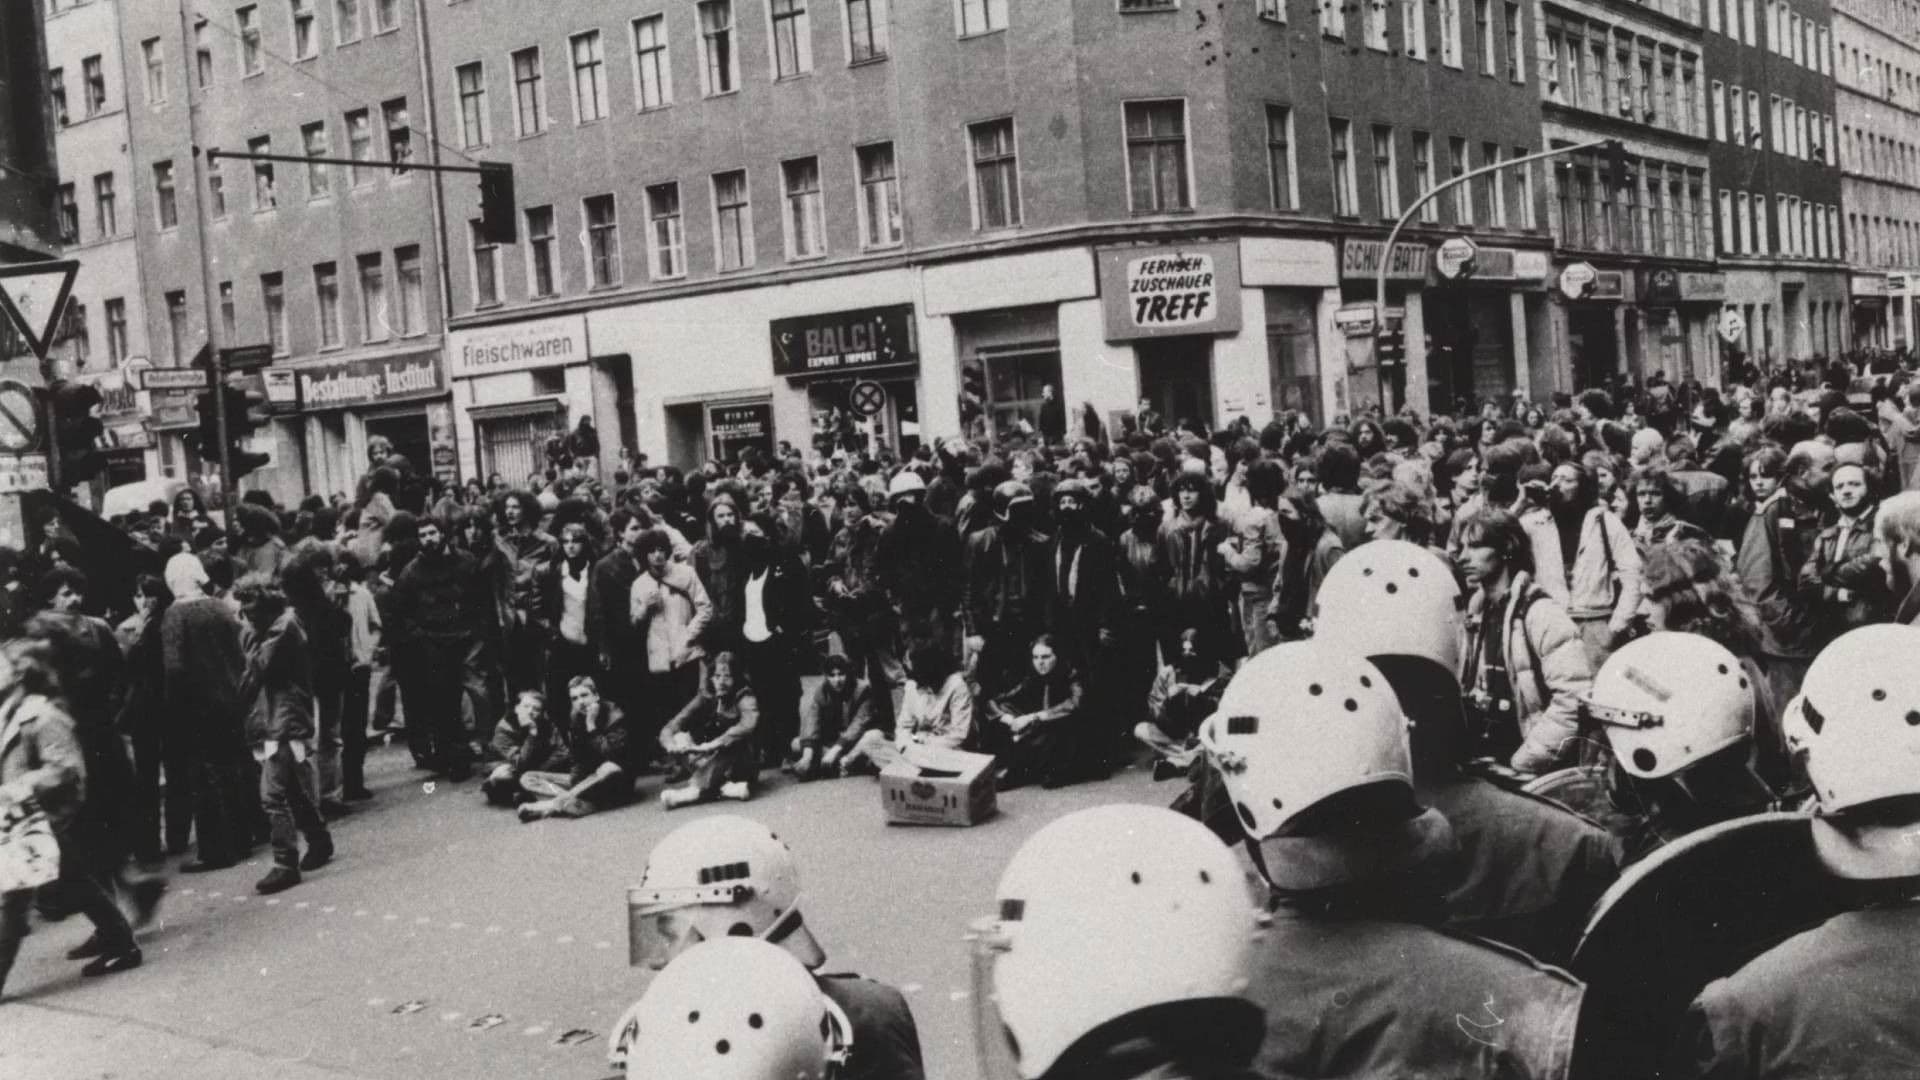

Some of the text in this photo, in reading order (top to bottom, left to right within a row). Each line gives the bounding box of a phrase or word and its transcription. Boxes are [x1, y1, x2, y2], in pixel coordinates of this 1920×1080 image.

[1394, 245, 1426, 272] BATT
[1131, 272, 1213, 293] ZUSCHAUER
[1136, 291, 1210, 324] TREFF
[463, 336, 573, 367] Fleischwaren
[806, 322, 877, 357] BALCI
[807, 350, 877, 368] EXPORT IMPORT
